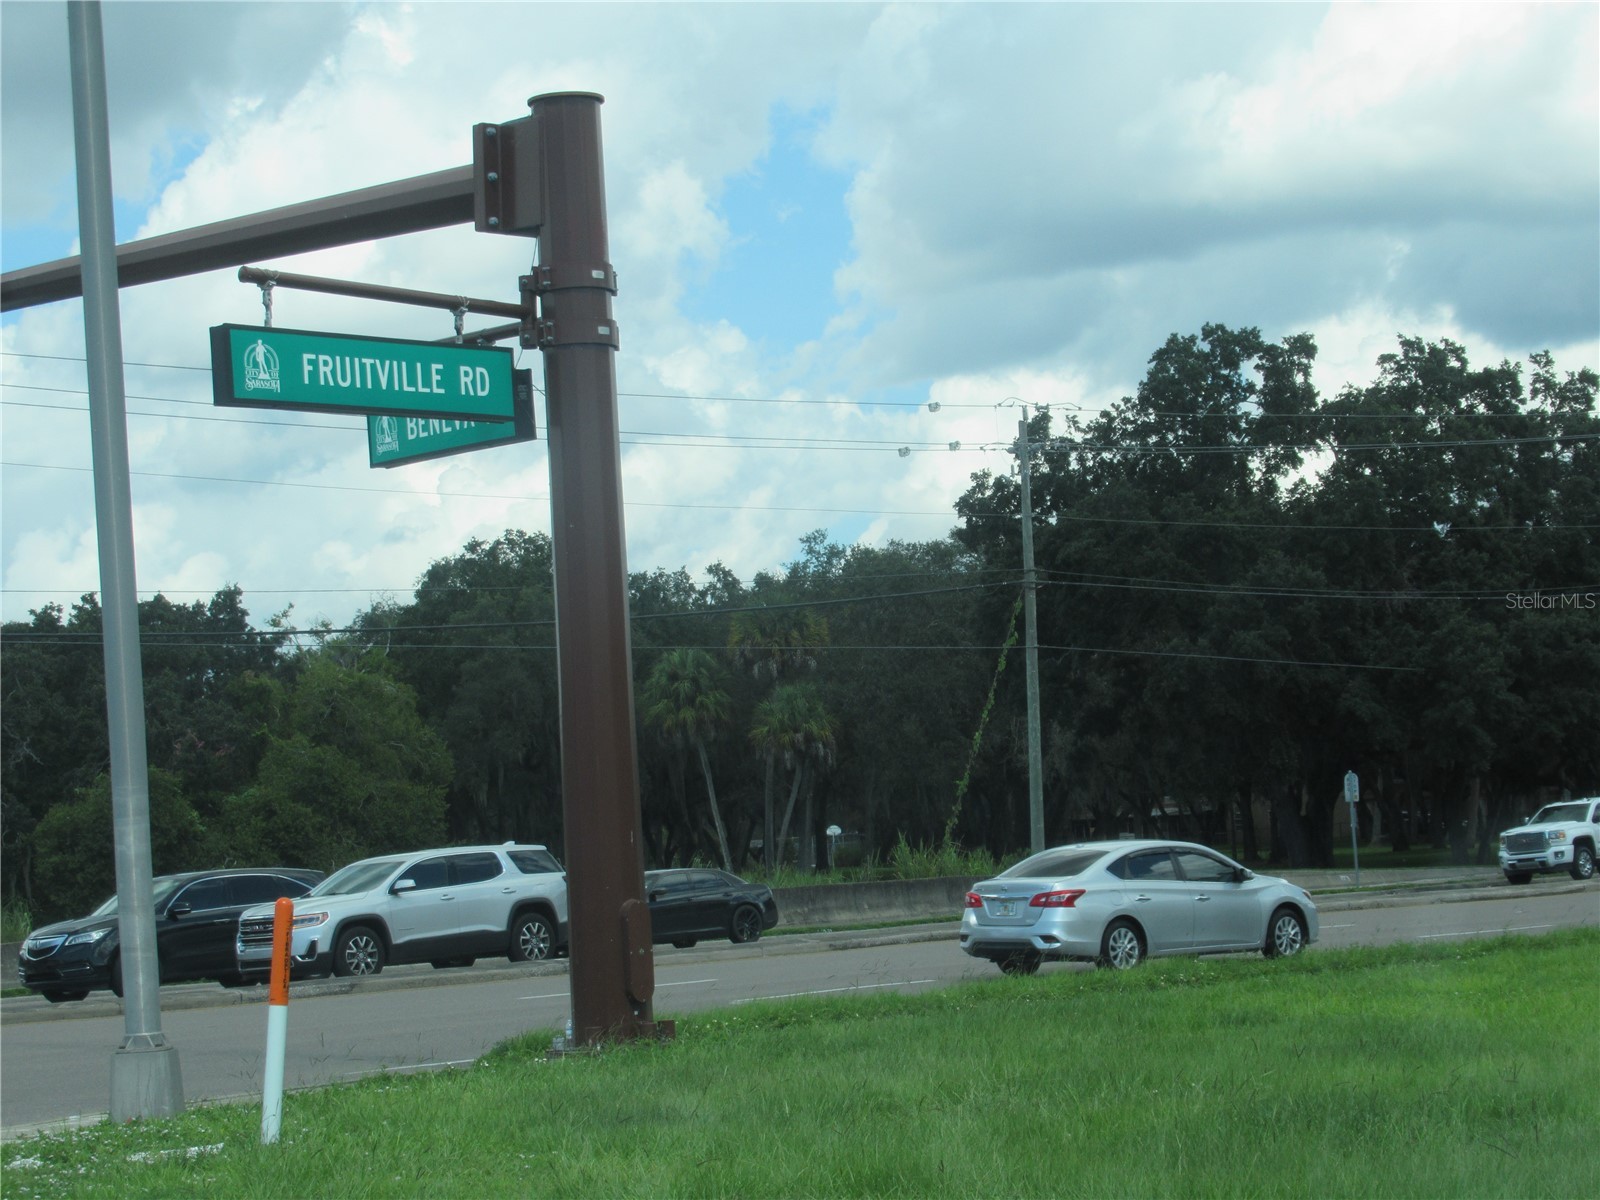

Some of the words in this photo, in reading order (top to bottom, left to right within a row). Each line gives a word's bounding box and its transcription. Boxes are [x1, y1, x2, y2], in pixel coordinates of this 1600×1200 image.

[245, 377, 281, 393] SARASOTA
[302, 353, 446, 394] FRUITVILLE
[459, 365, 490, 397] RD
